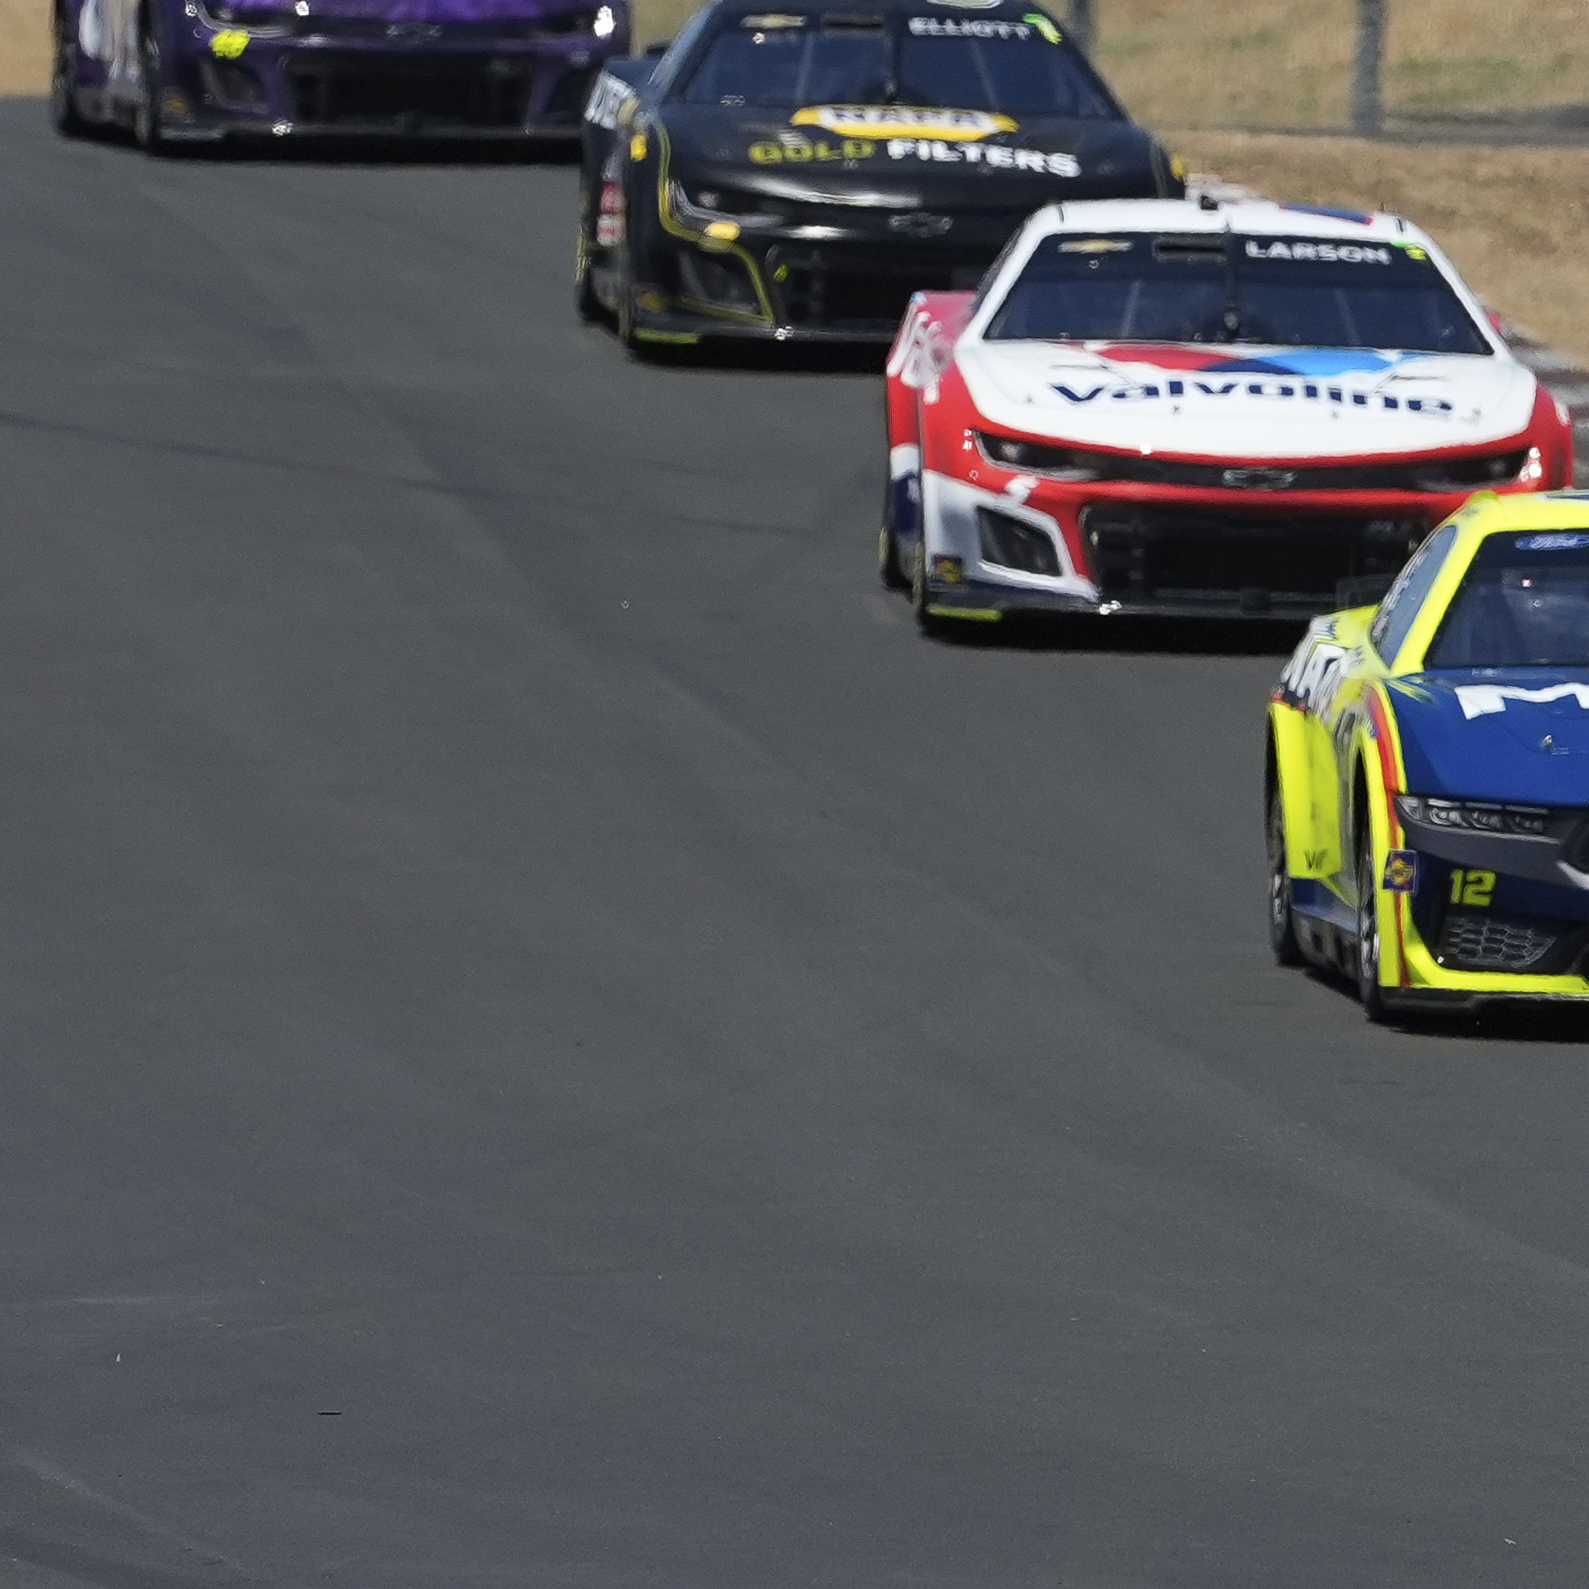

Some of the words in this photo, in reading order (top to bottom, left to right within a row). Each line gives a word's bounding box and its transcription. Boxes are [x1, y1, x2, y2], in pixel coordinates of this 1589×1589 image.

[749, 140, 876, 165] GOLD
[887, 138, 1082, 177] FILTERS
[1245, 240, 1392, 265] LARSON
[1049, 379, 1452, 413] Valvoline
[1451, 869, 1496, 907] 12
